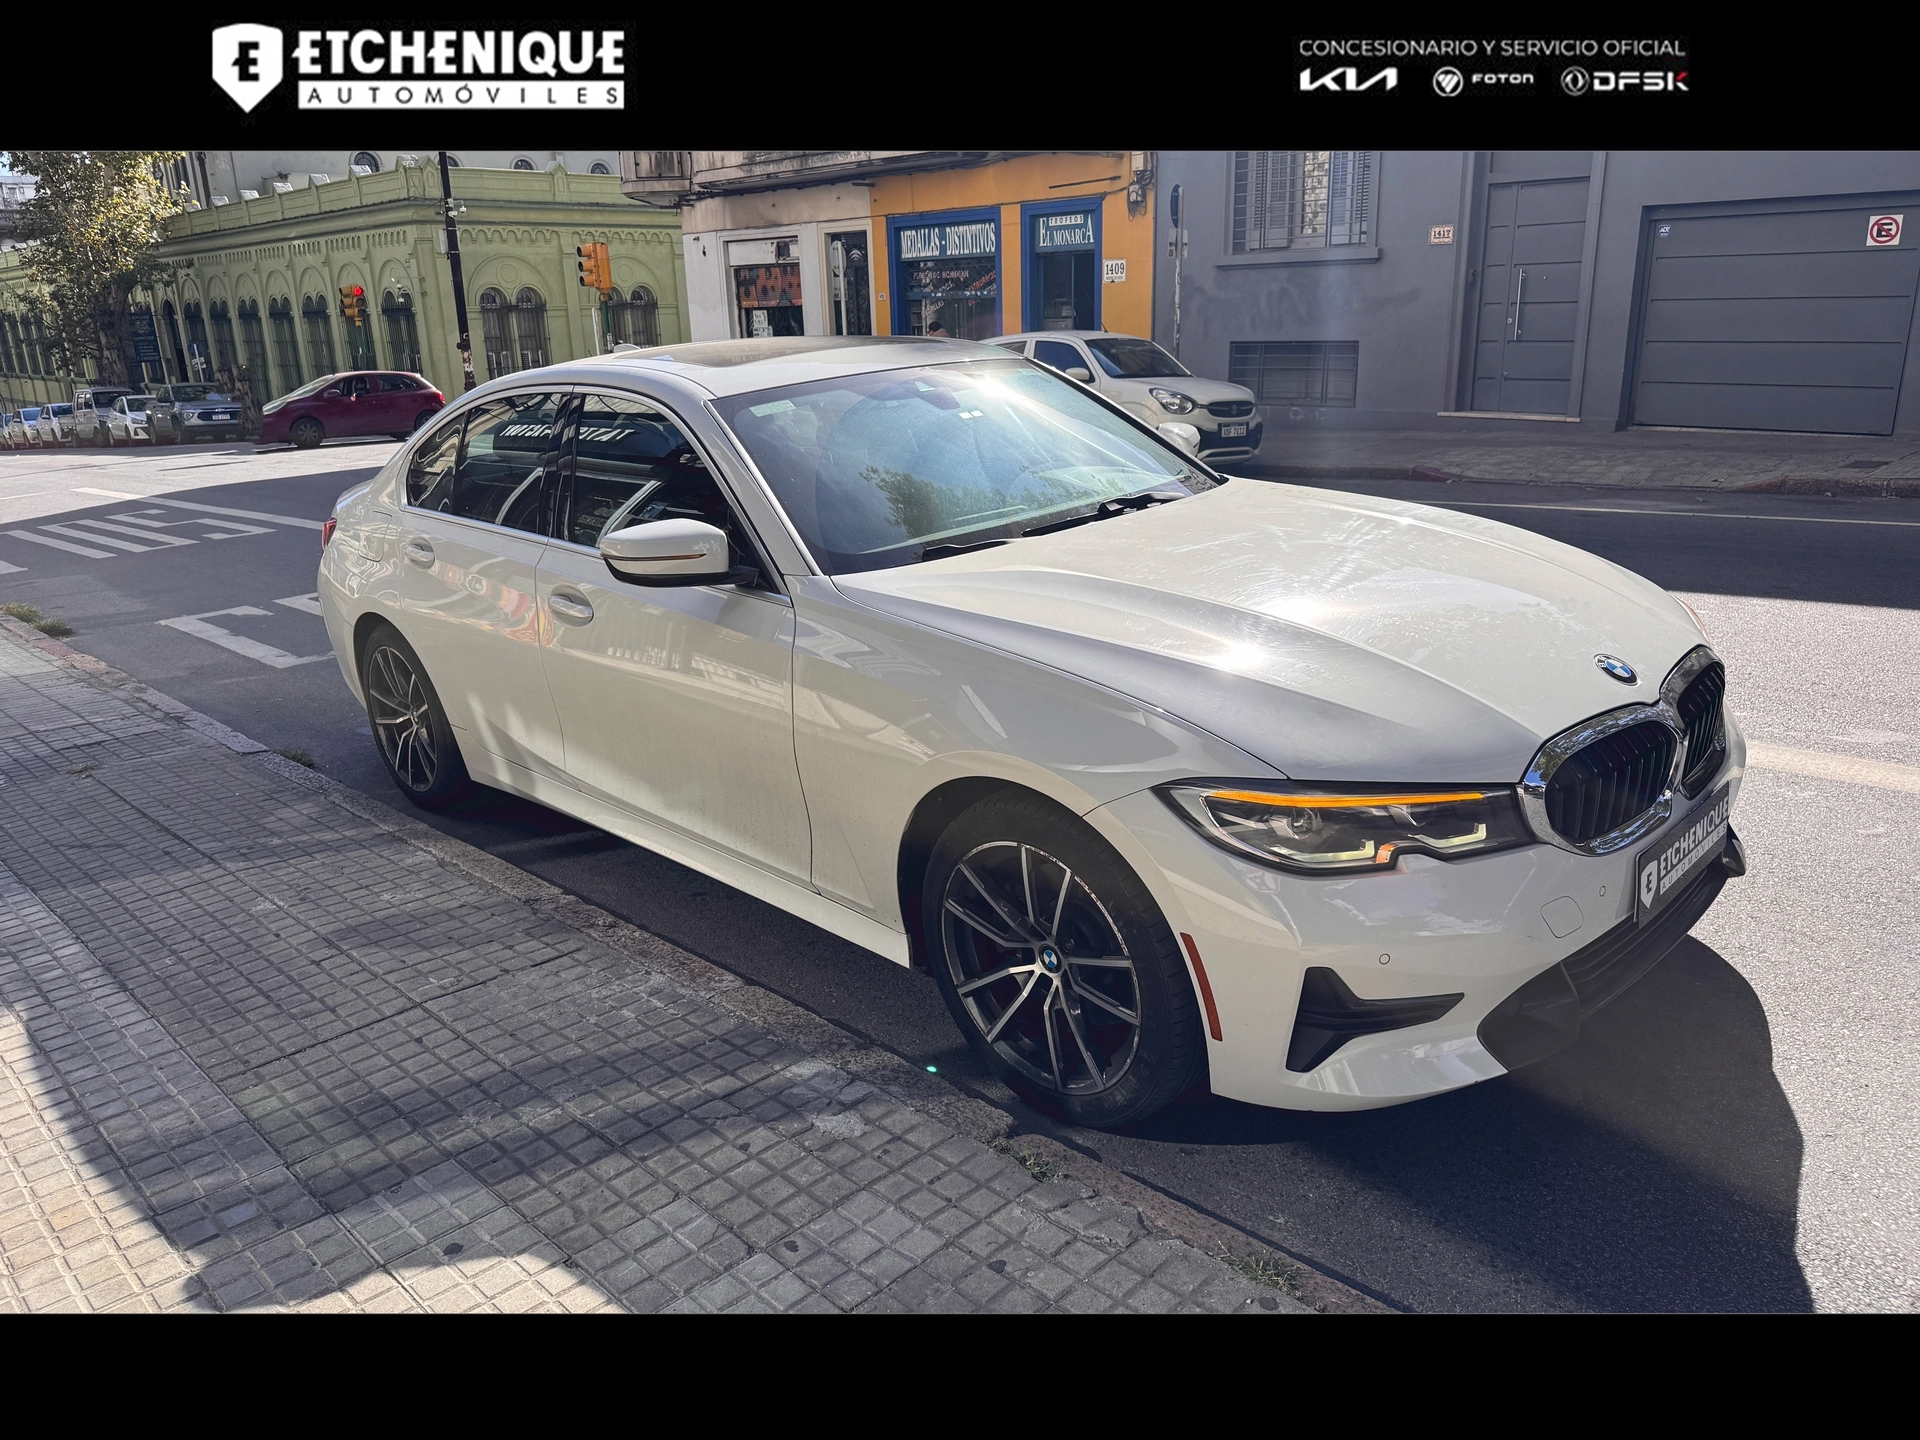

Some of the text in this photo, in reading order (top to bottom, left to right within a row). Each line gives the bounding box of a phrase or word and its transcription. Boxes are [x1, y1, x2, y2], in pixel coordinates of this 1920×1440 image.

[1050, 214, 1084, 226] TROFEOS
[1053, 213, 1095, 247] MONARCA
[901, 227, 940, 258] MEDALLAS
[945, 222, 996, 256] DISTINTIVOS
[1433, 229, 1451, 237] 1417
[1105, 262, 1125, 276] 1409
[1660, 796, 1729, 878] ETCHENIQUE
